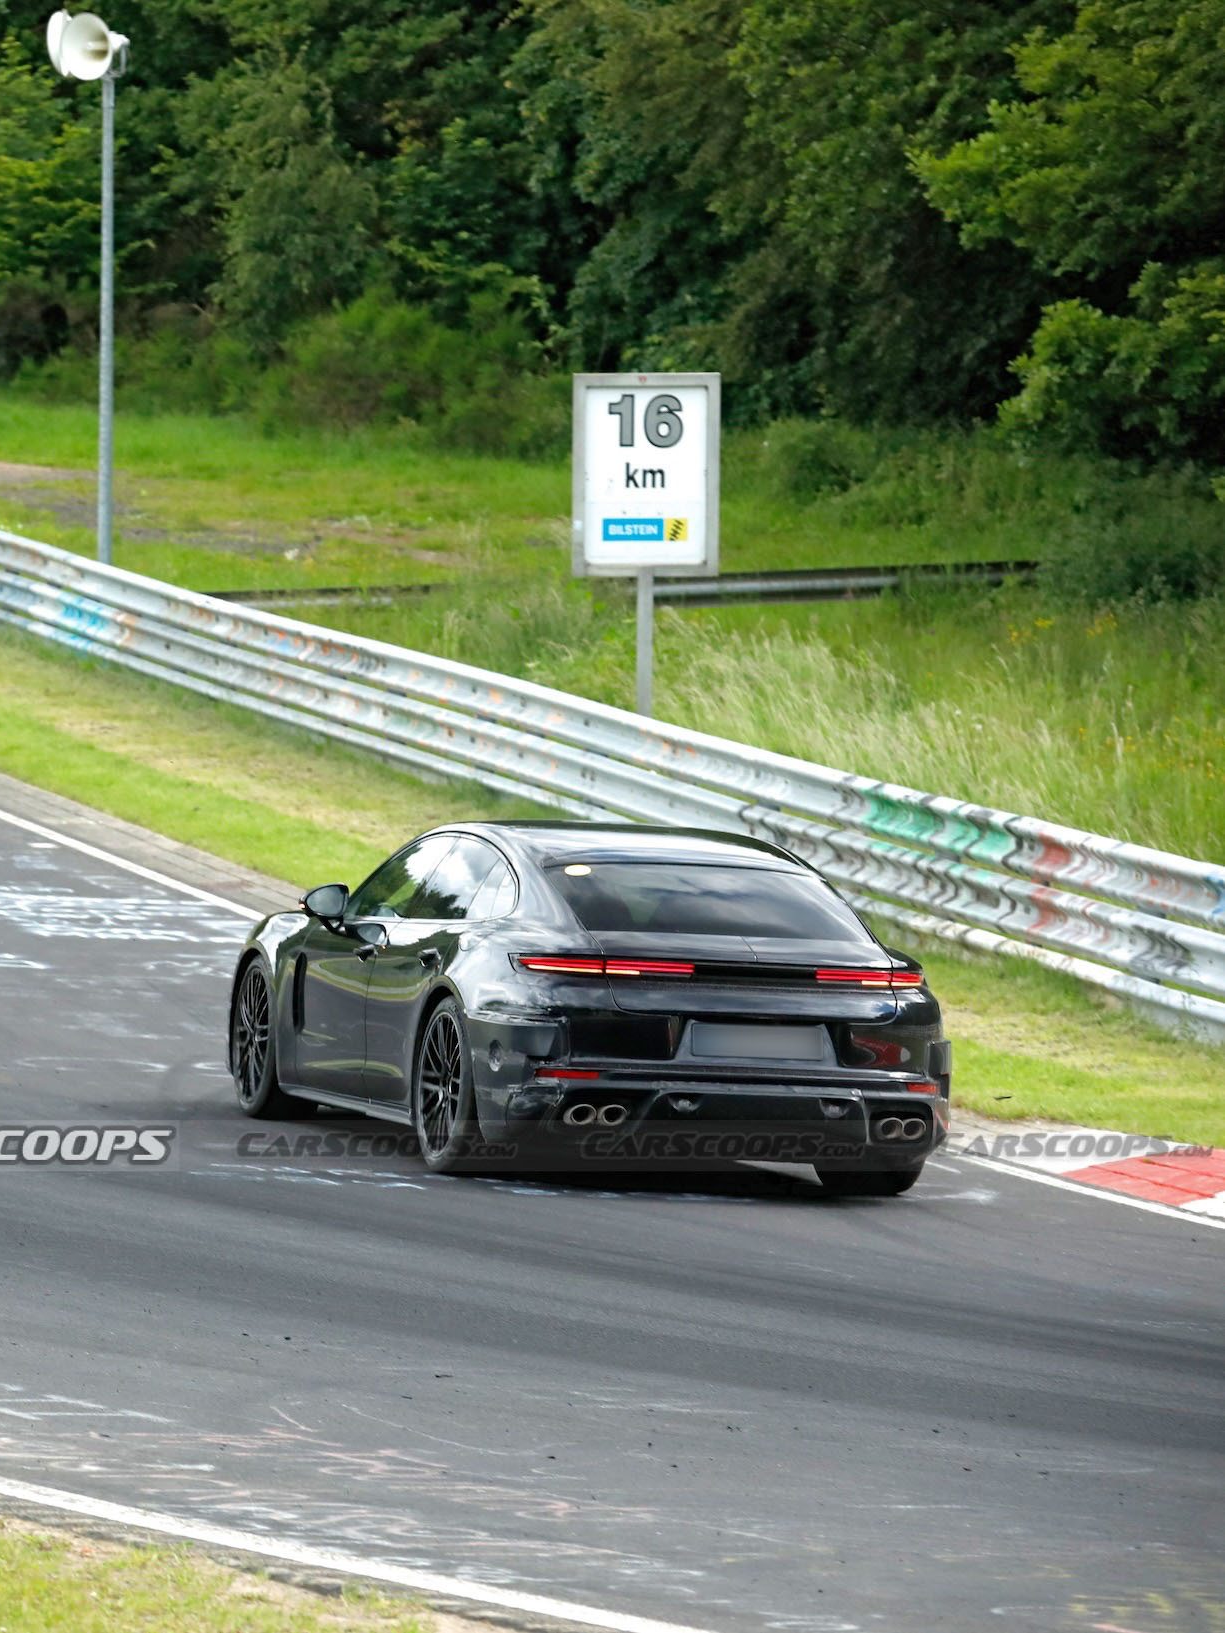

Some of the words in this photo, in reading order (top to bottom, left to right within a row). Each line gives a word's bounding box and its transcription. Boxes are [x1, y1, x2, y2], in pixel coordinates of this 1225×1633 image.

[608, 394, 684, 448] 16
[625, 462, 665, 488] km
[608, 524, 658, 536] BILSTEIN
